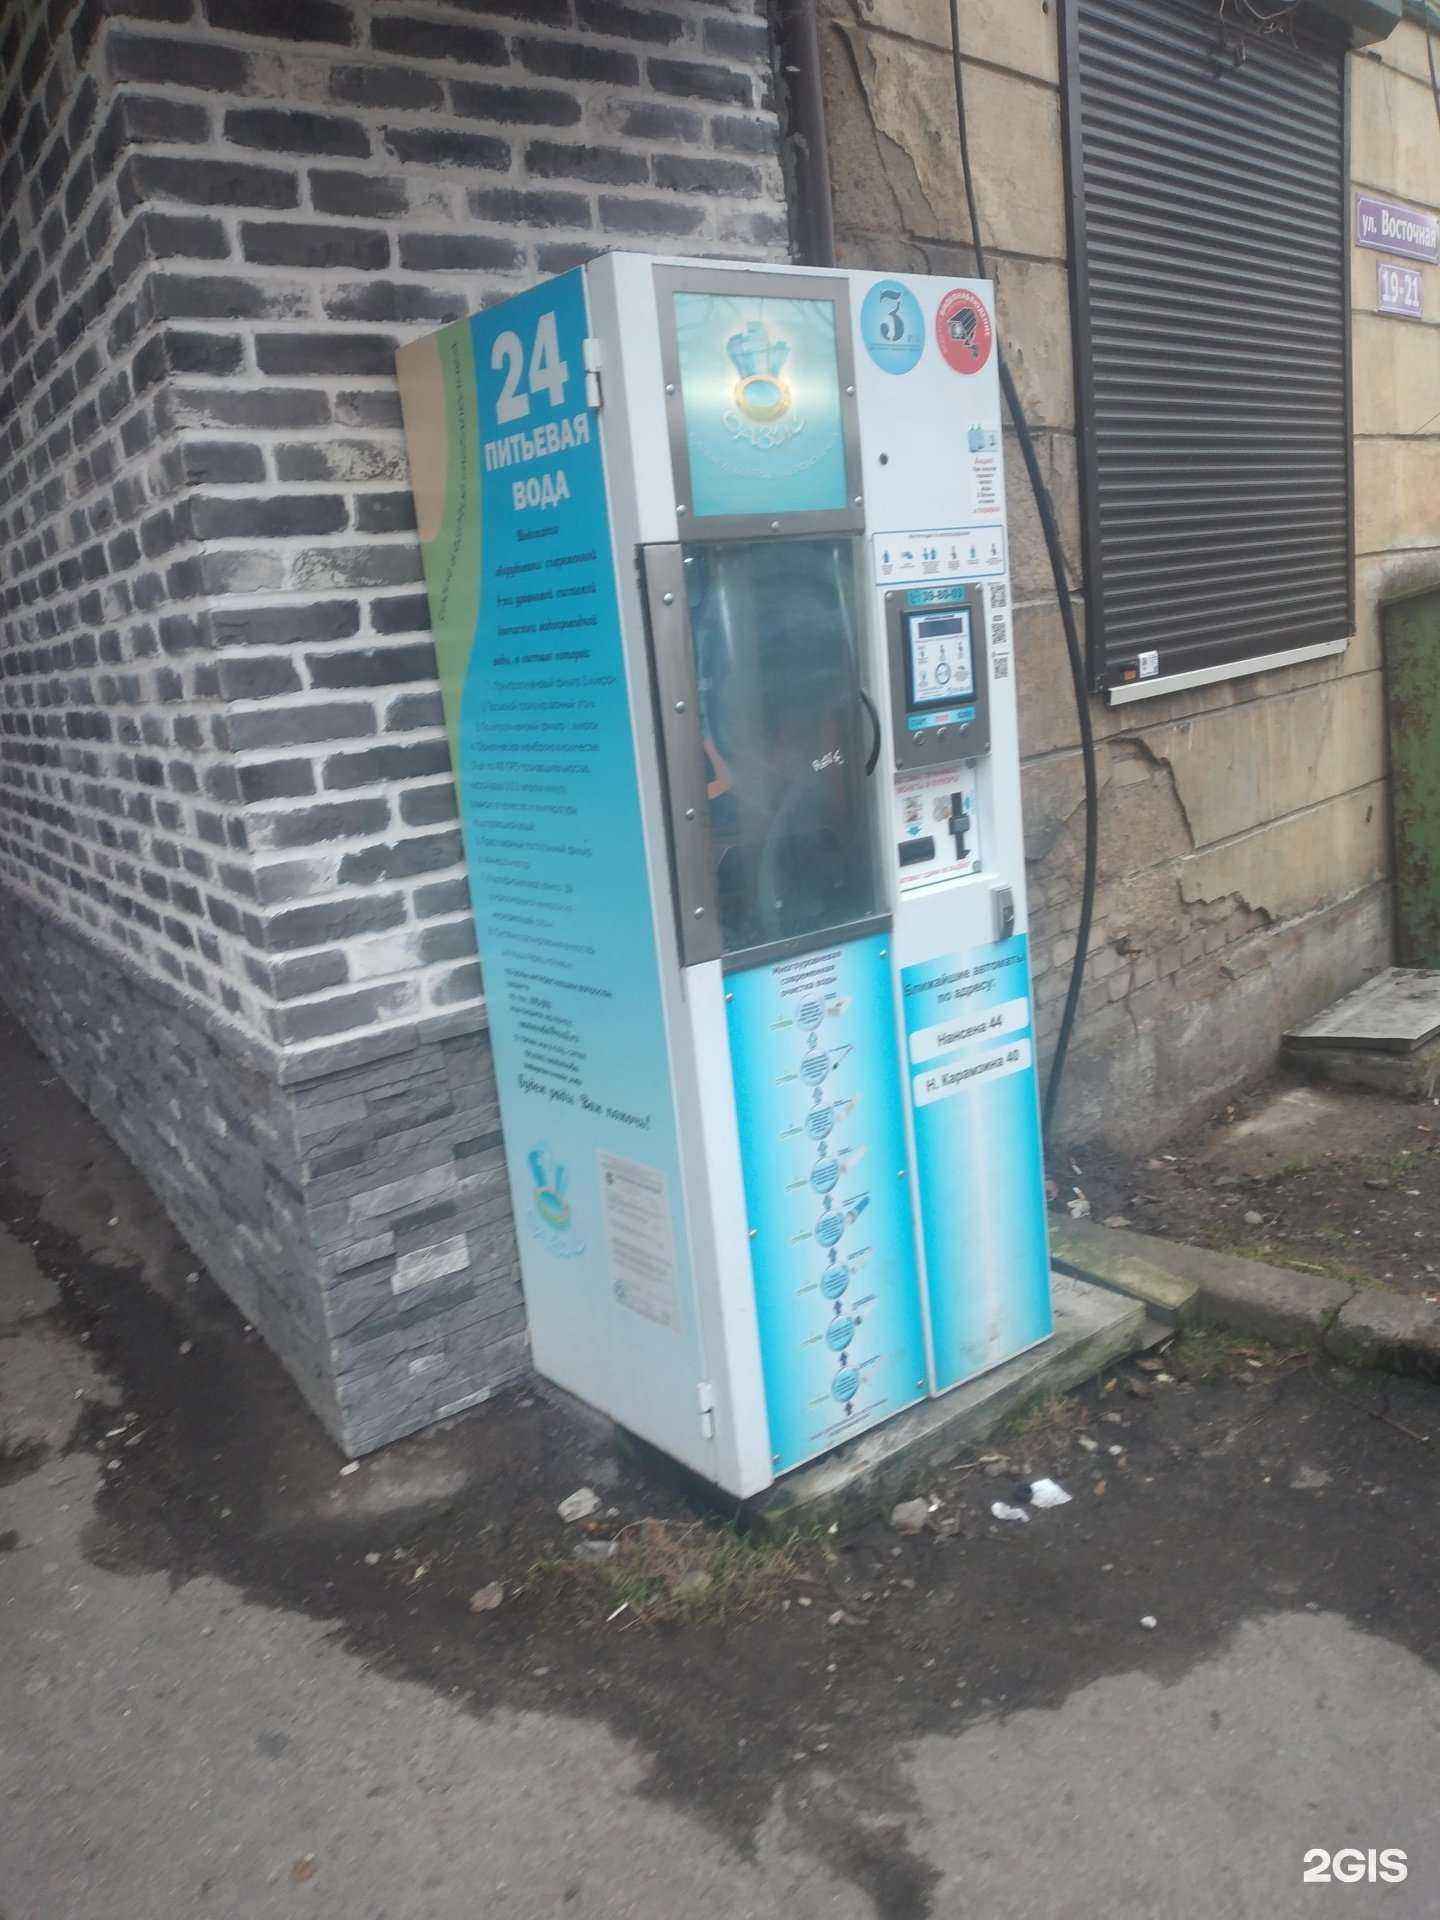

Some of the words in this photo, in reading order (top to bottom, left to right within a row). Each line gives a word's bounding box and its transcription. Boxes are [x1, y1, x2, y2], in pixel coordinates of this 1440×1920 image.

[1362, 214, 1377, 236] ул.
[1381, 208, 1438, 249] Восточная
[1381, 269, 1420, 308] 19-21
[879, 289, 905, 342] 3
[490, 310, 570, 425] 24
[484, 412, 589, 472] ПИТЬЕВАЯ
[511, 469, 571, 512] ВОДА
[903, 968, 971, 997] Ближайшие
[972, 953, 1024, 976] автоматы
[937, 992, 951, 1004] по
[937, 1022, 987, 1047] Нансена
[989, 1013, 1004, 1028] 44
[925, 1077, 939, 1092] Н.
[940, 1057, 1004, 1087] Карамзина
